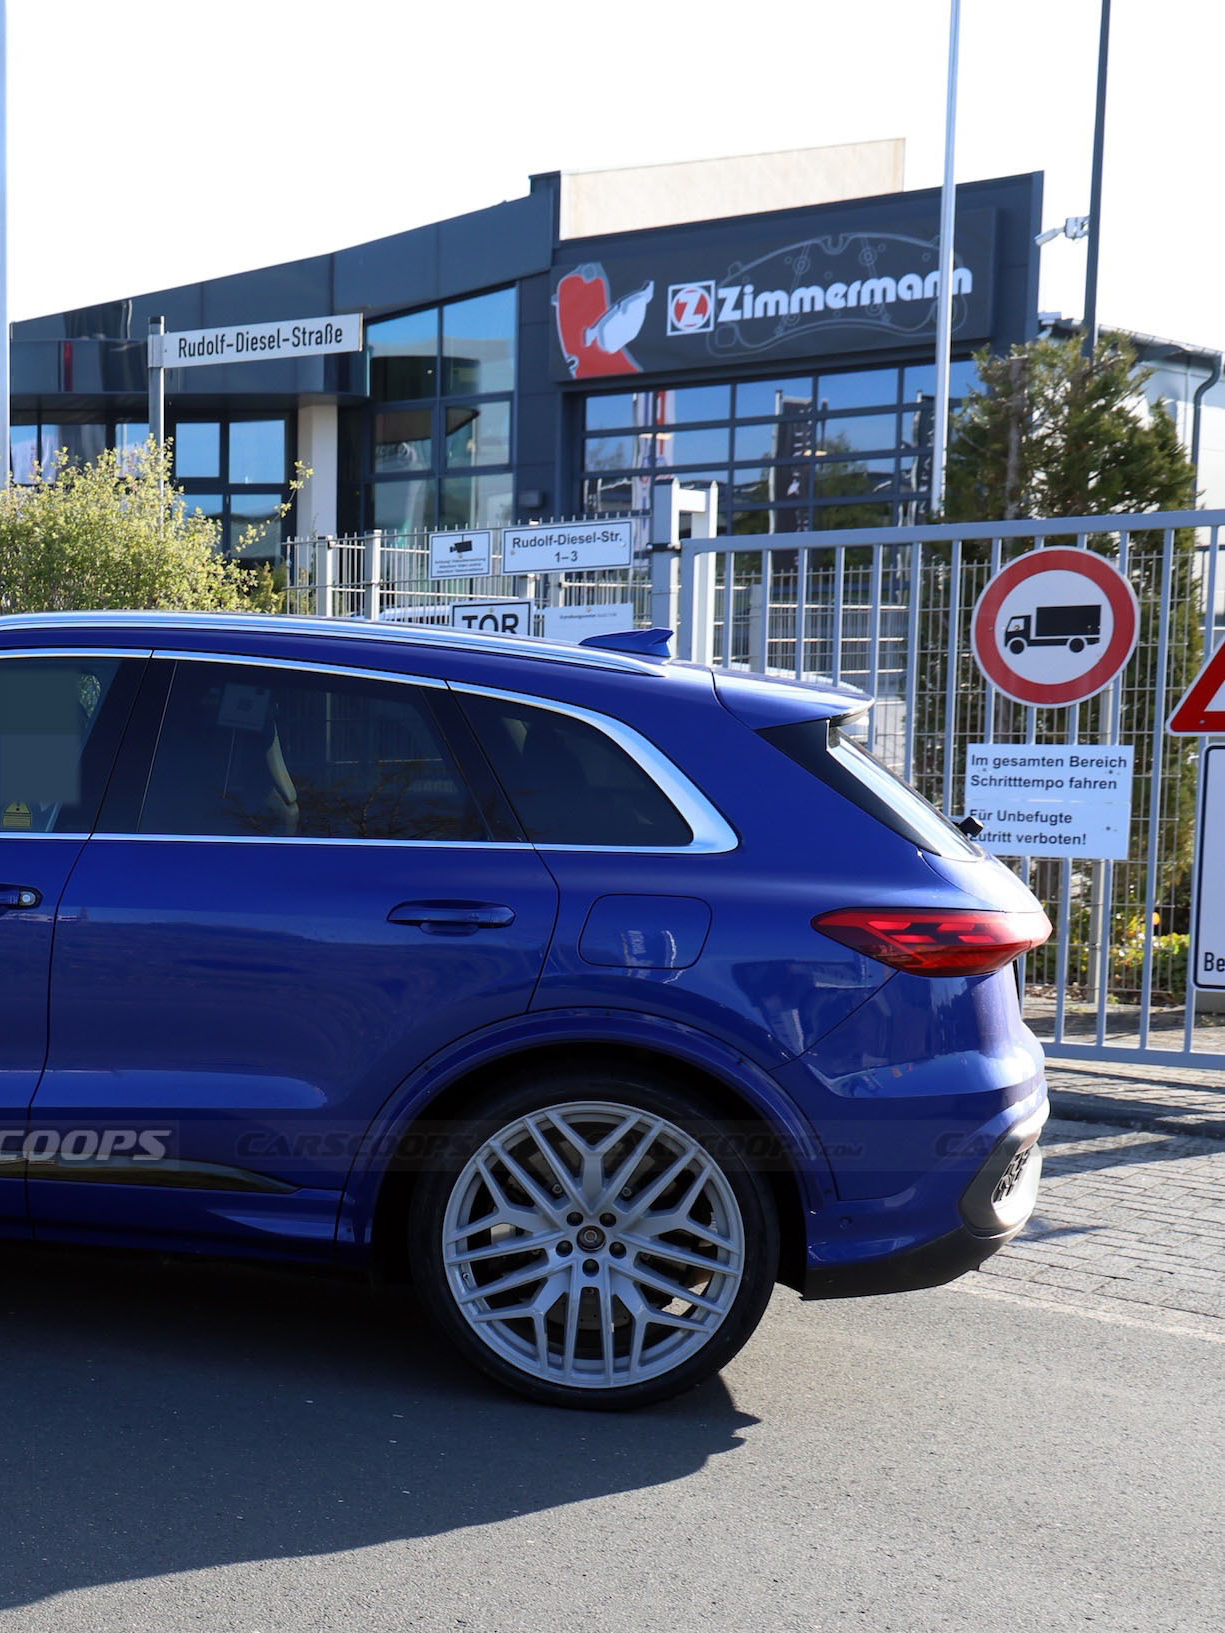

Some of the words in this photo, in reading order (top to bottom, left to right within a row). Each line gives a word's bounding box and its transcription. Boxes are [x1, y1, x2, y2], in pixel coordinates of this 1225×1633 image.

[717, 267, 973, 323] Zimmermann
[178, 323, 343, 358] Rudolf-Diesel-Straße
[512, 531, 623, 548] Rudolf-Diesel-Str.
[461, 613, 519, 634] TOR
[971, 755, 988, 766] Im
[993, 756, 1064, 769] gesamten
[1069, 756, 1127, 768] Bereich
[970, 775, 1064, 790] Schritttempo
[1069, 777, 1117, 789] fahren
[997, 810, 1073, 826] Unbefugte
[970, 831, 1011, 843] utritt
[1016, 833, 1087, 845] verboten!
